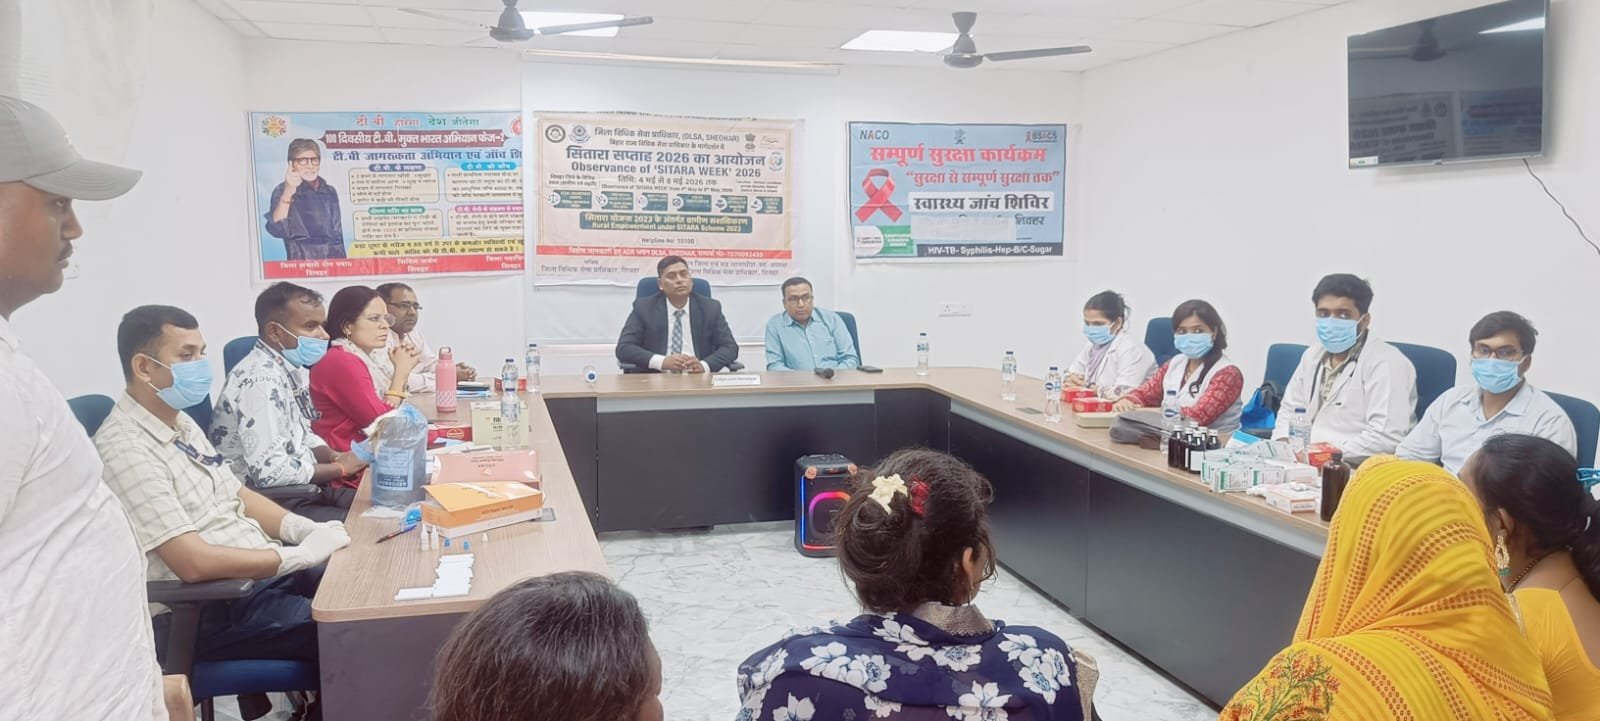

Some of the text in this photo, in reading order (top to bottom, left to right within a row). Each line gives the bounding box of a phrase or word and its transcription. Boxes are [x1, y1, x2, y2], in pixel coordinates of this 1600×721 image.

[428, 114, 446, 126] देश
[594, 127, 612, 136] जिला
[614, 128, 636, 136] विधिक
[637, 128, 650, 136] सेवा
[859, 130, 890, 140] NACO
[338, 132, 371, 144] दिवसीय
[398, 132, 419, 147] मुक्त
[420, 133, 442, 144] भारत
[442, 131, 477, 144] अभियान
[420, 150, 462, 160] अभियान
[466, 150, 480, 160] एवं
[566, 145, 766, 166] सितारा सप्ताह 2026 का आयोजन
[870, 144, 924, 167] सम्पूर्ण
[929, 147, 976, 166] सुरक्षा
[571, 162, 636, 173] Observance
[640, 164, 650, 174] of
[735, 168, 761, 178] 2026
[645, 176, 656, 184] मई
[658, 176, 665, 184] से
[672, 176, 683, 186] मई
[948, 170, 958, 184] से
[962, 170, 997, 187] सम्पूर्ण
[1000, 172, 1030, 187] सुरक्षा
[968, 194, 1001, 210] जांच
[1004, 194, 1050, 210] शिविर
[634, 214, 652, 222] 2023
[654, 214, 662, 222] के
[1014, 213, 1046, 226] शिवहर
[610, 222, 656, 230] Empowerment
